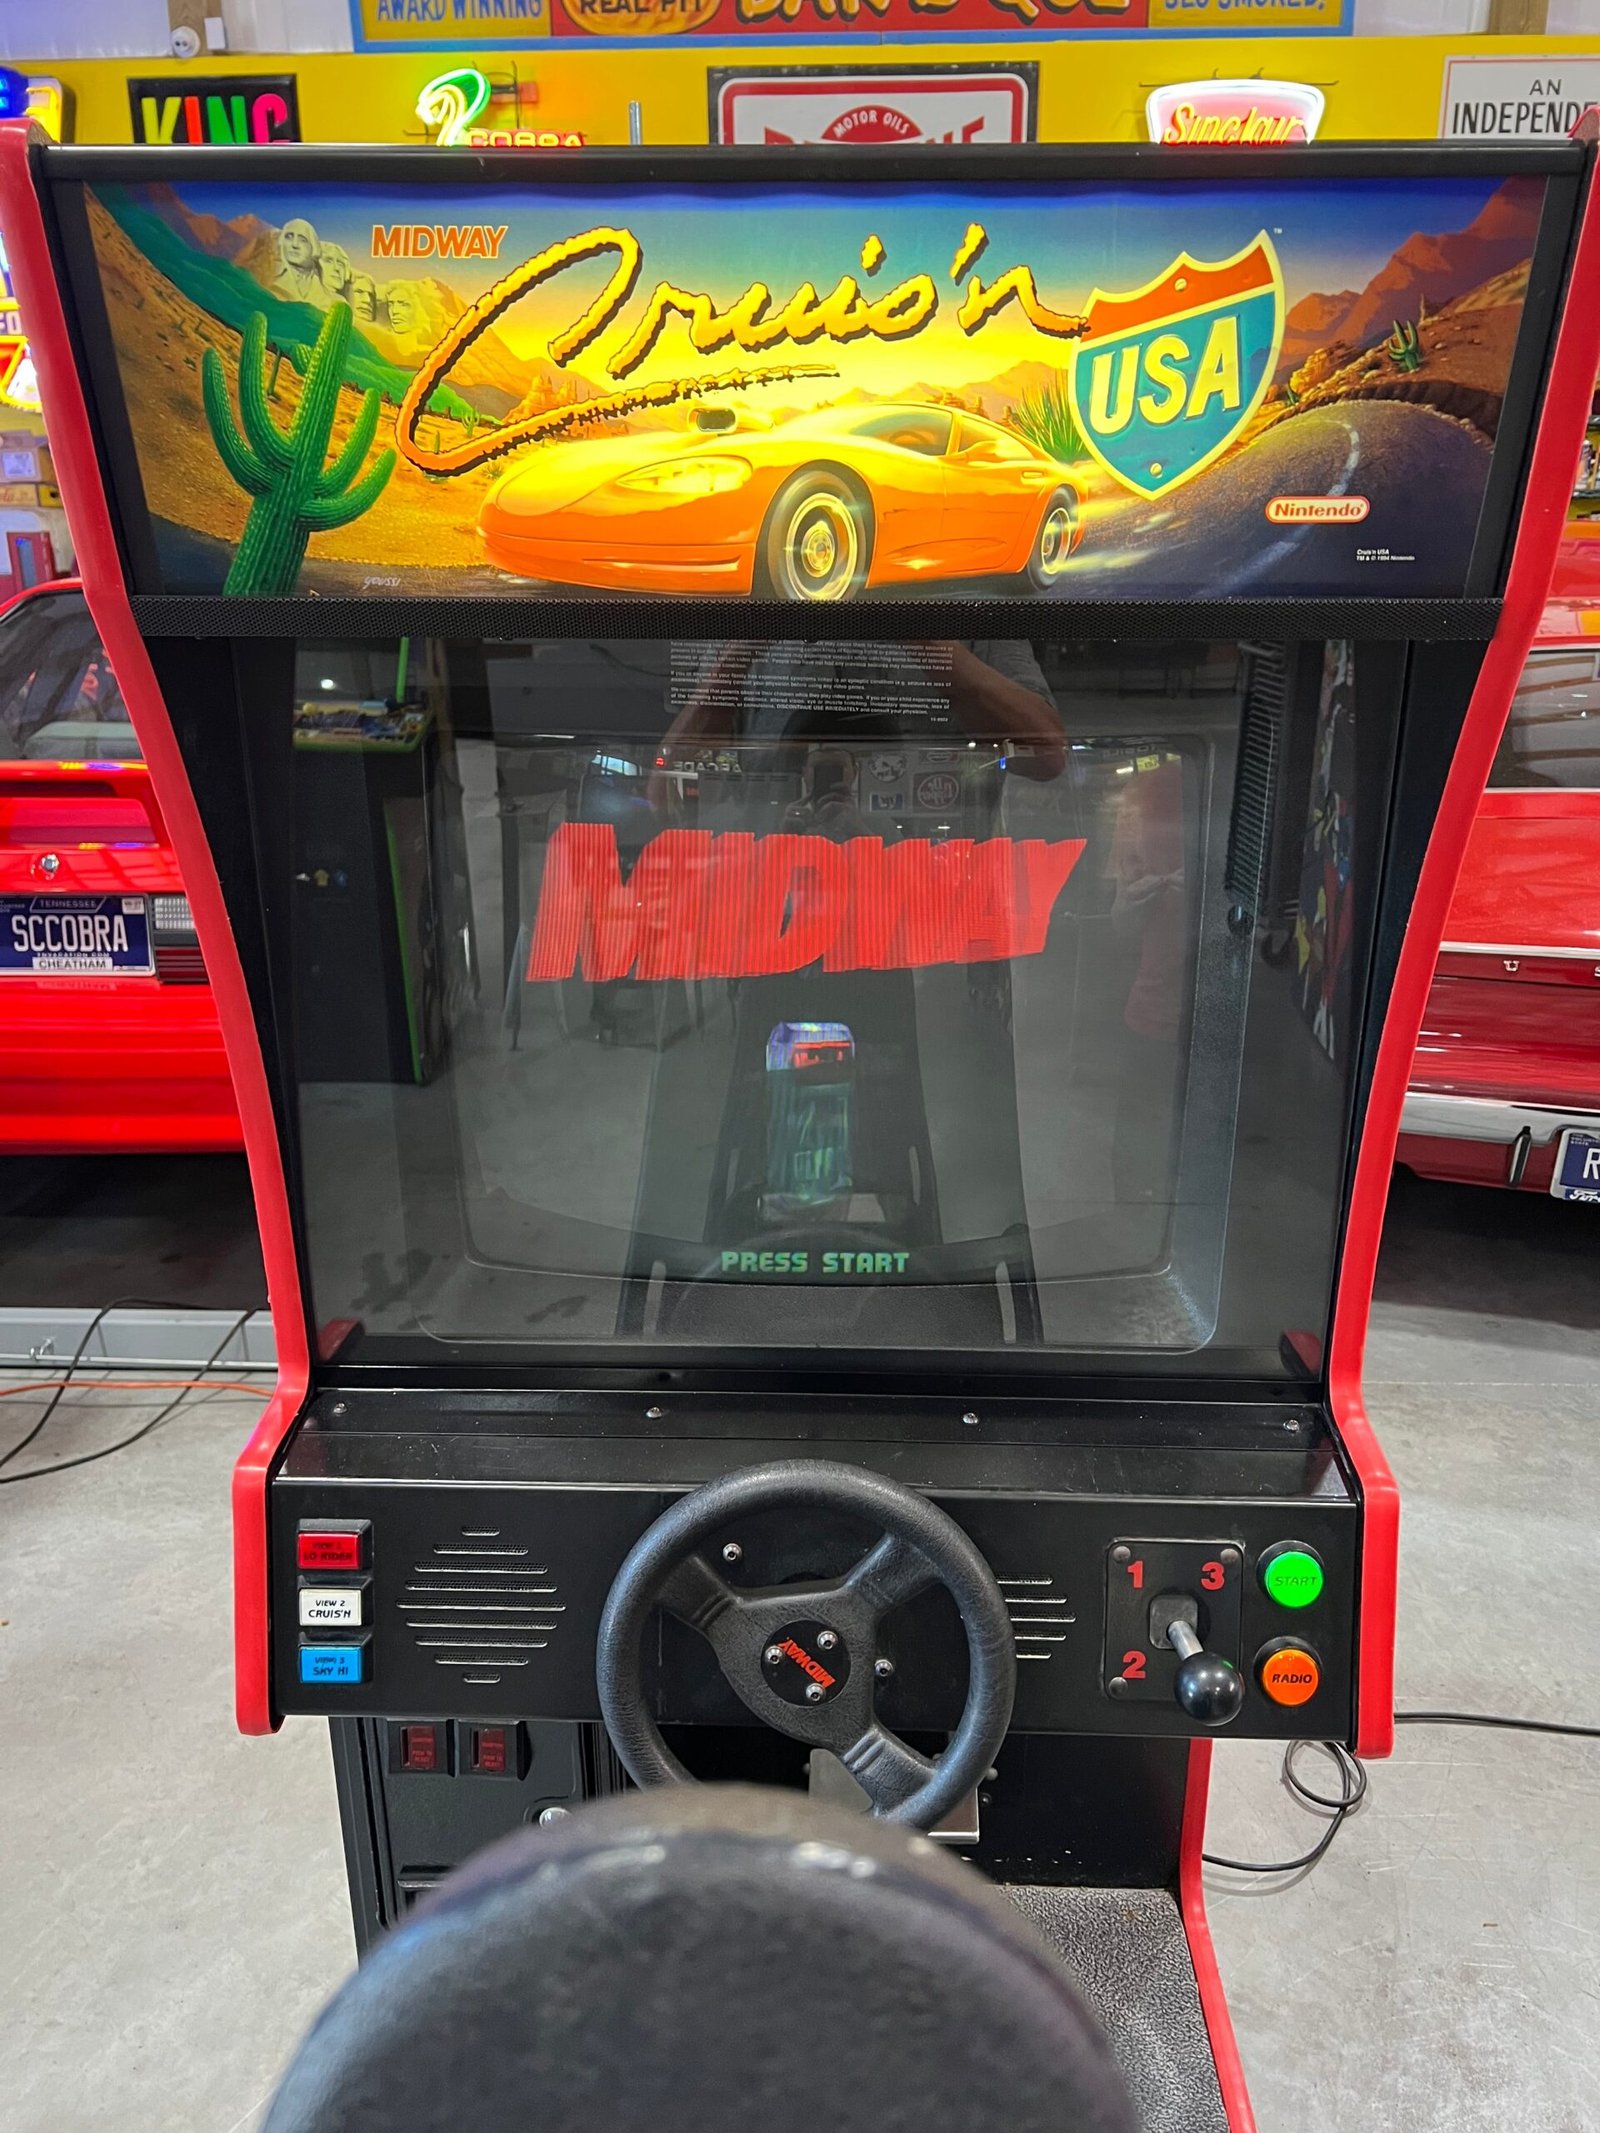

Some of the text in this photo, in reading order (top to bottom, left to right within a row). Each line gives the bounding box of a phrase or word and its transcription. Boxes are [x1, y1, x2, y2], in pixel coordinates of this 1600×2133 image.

[377, 0, 542, 22] AWARD WINNING
[1529, 79, 1562, 96] AN
[833, 110, 878, 138] MOTOR
[883, 112, 910, 134] OILS
[1163, 102, 1306, 145] Sinclair
[371, 225, 508, 259] MIDWAY
[396, 223, 1243, 476] Cruis'n USA
[525, 822, 1088, 982] MIDWAY
[11, 914, 129, 952] SCCOBRA
[39, 960, 107, 969] CHEATHAM
[721, 1251, 910, 1274] PRESS START
[1127, 1560, 1144, 1589] 1
[1200, 1561, 1225, 1591] 3
[1274, 1575, 1318, 1587] START
[308, 1609, 351, 1618] CRUIS'N
[315, 1599, 346, 1607] VIEW 2
[312, 1666, 349, 1676] SKY HI
[777, 1638, 836, 1689] MIDWAY
[1122, 1650, 1147, 1679] 2
[1271, 1673, 1313, 1684] RADIO
